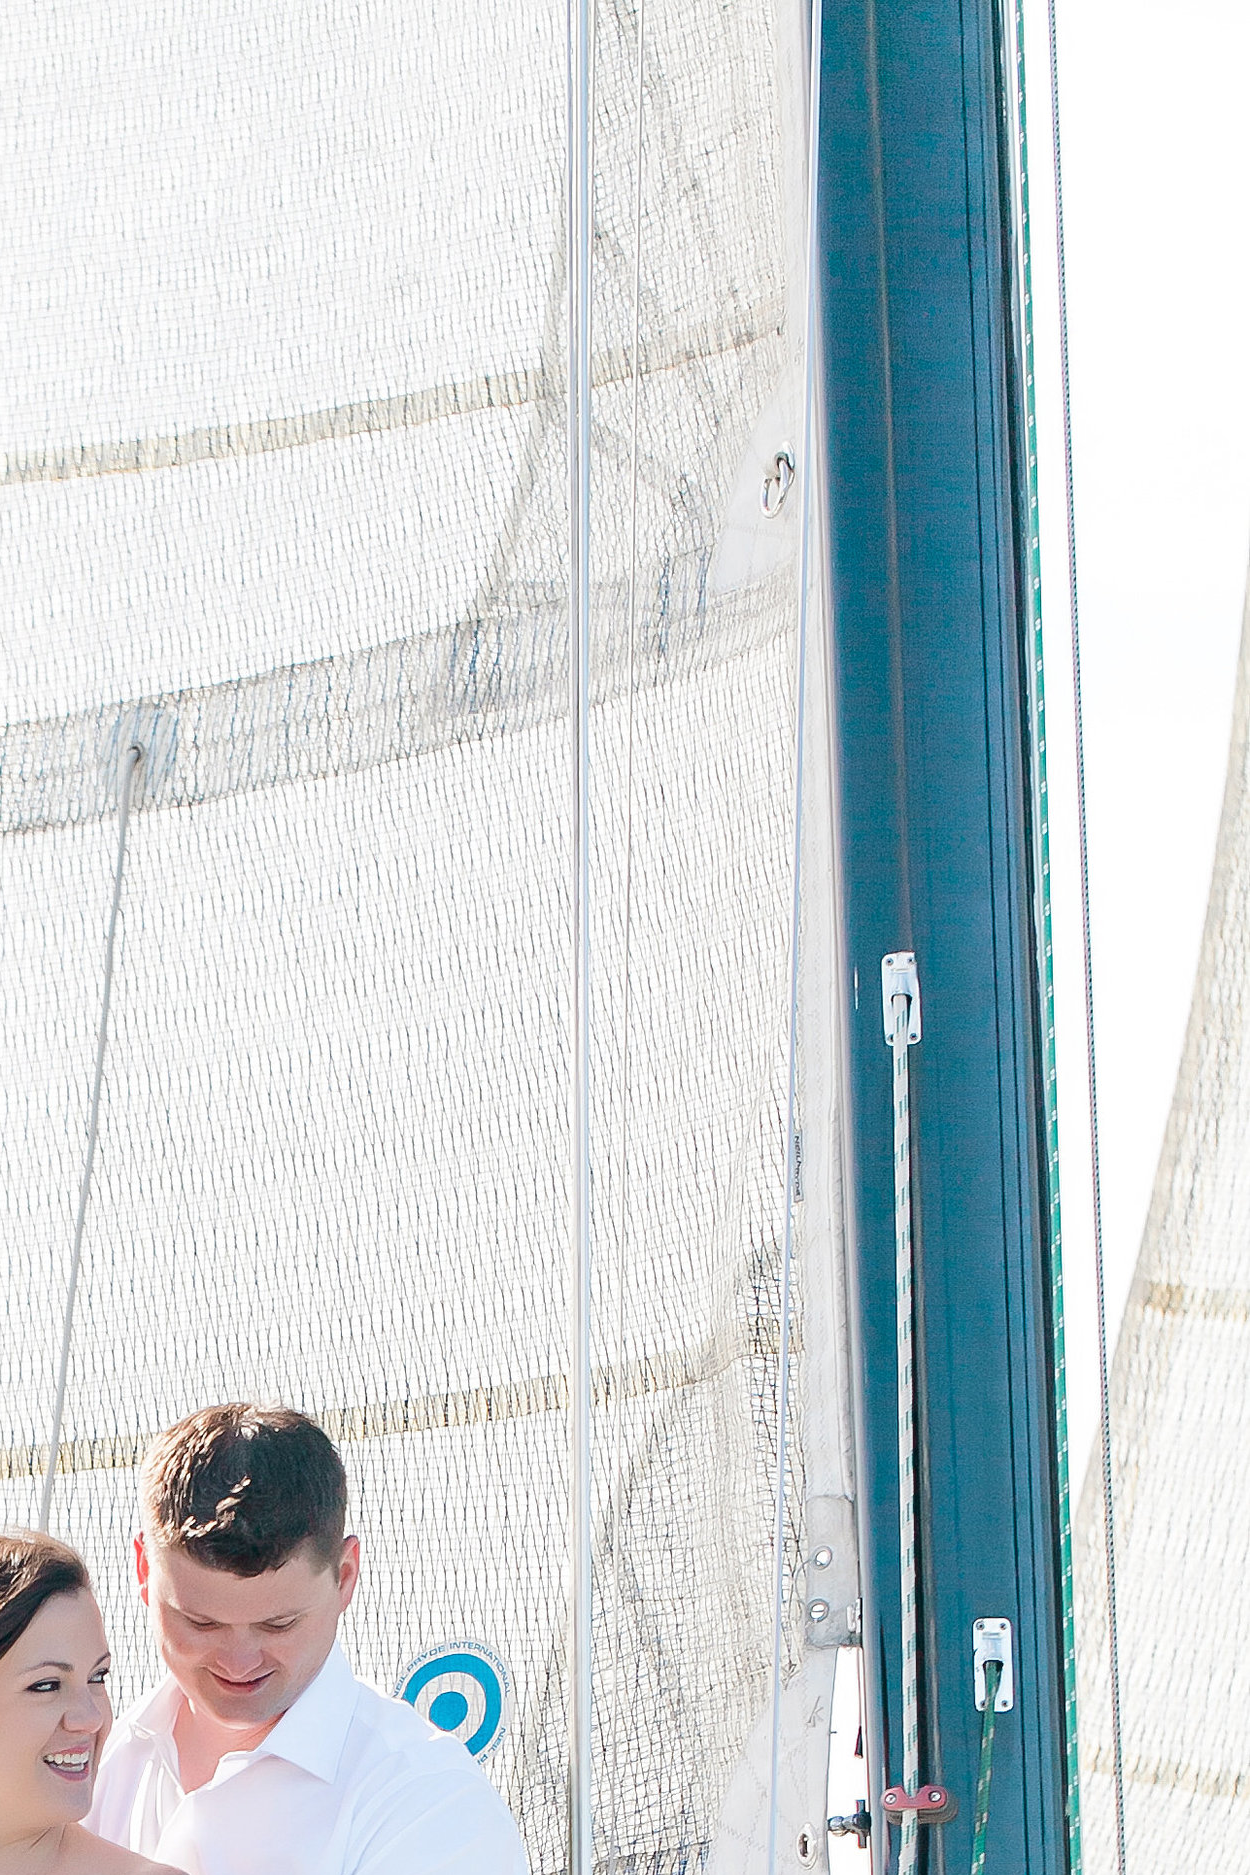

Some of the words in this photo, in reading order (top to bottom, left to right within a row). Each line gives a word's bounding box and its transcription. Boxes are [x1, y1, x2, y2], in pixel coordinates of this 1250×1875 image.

[392, 1675, 406, 1698] NEIL
[406, 1646, 446, 1672] PRYDE
[449, 1641, 511, 1698] INTERNATIONAL
[488, 1727, 506, 1752] NEIL
